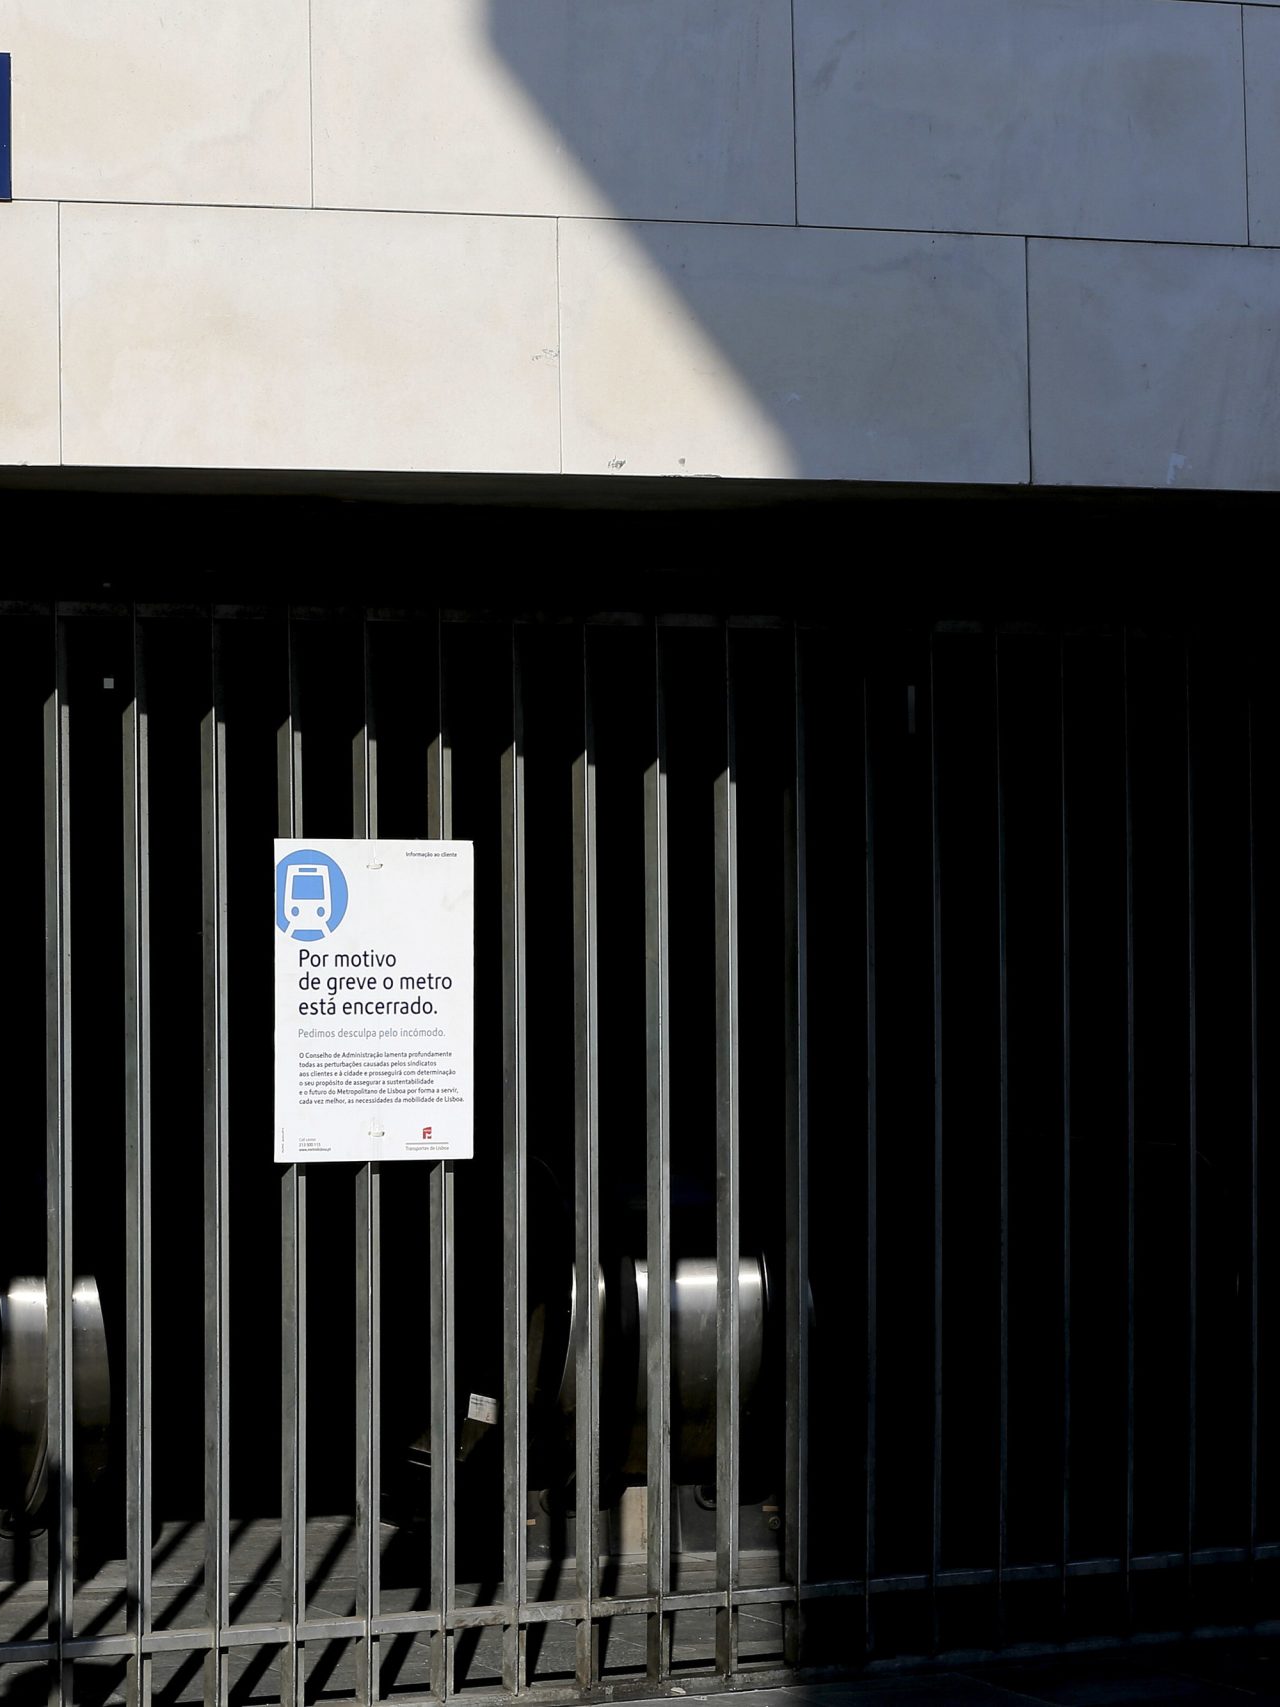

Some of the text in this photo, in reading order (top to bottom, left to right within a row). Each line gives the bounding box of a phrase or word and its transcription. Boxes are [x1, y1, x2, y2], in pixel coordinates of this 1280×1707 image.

[299, 949, 396, 967] Por motivo
[299, 971, 452, 995] de greve o metro
[299, 996, 438, 1015] está encerrado.
[298, 1028, 446, 1039] Pedimos desculpa pelo incómodo.
